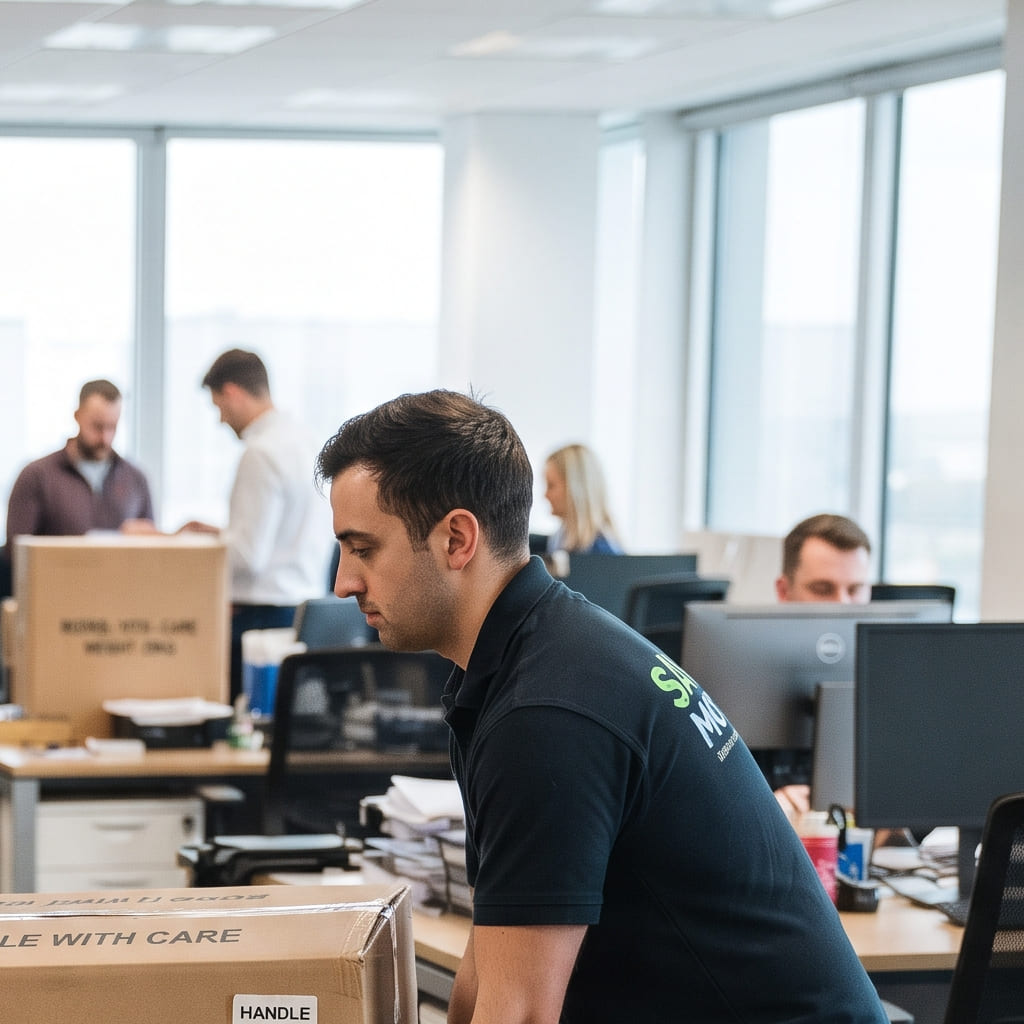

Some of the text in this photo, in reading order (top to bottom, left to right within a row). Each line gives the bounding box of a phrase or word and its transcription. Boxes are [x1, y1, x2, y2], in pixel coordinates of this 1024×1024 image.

[689, 690, 728, 749] MO
[53, 932, 136, 947] WITH
[146, 928, 242, 945] CARE
[240, 1006, 311, 1020] HANDLE
